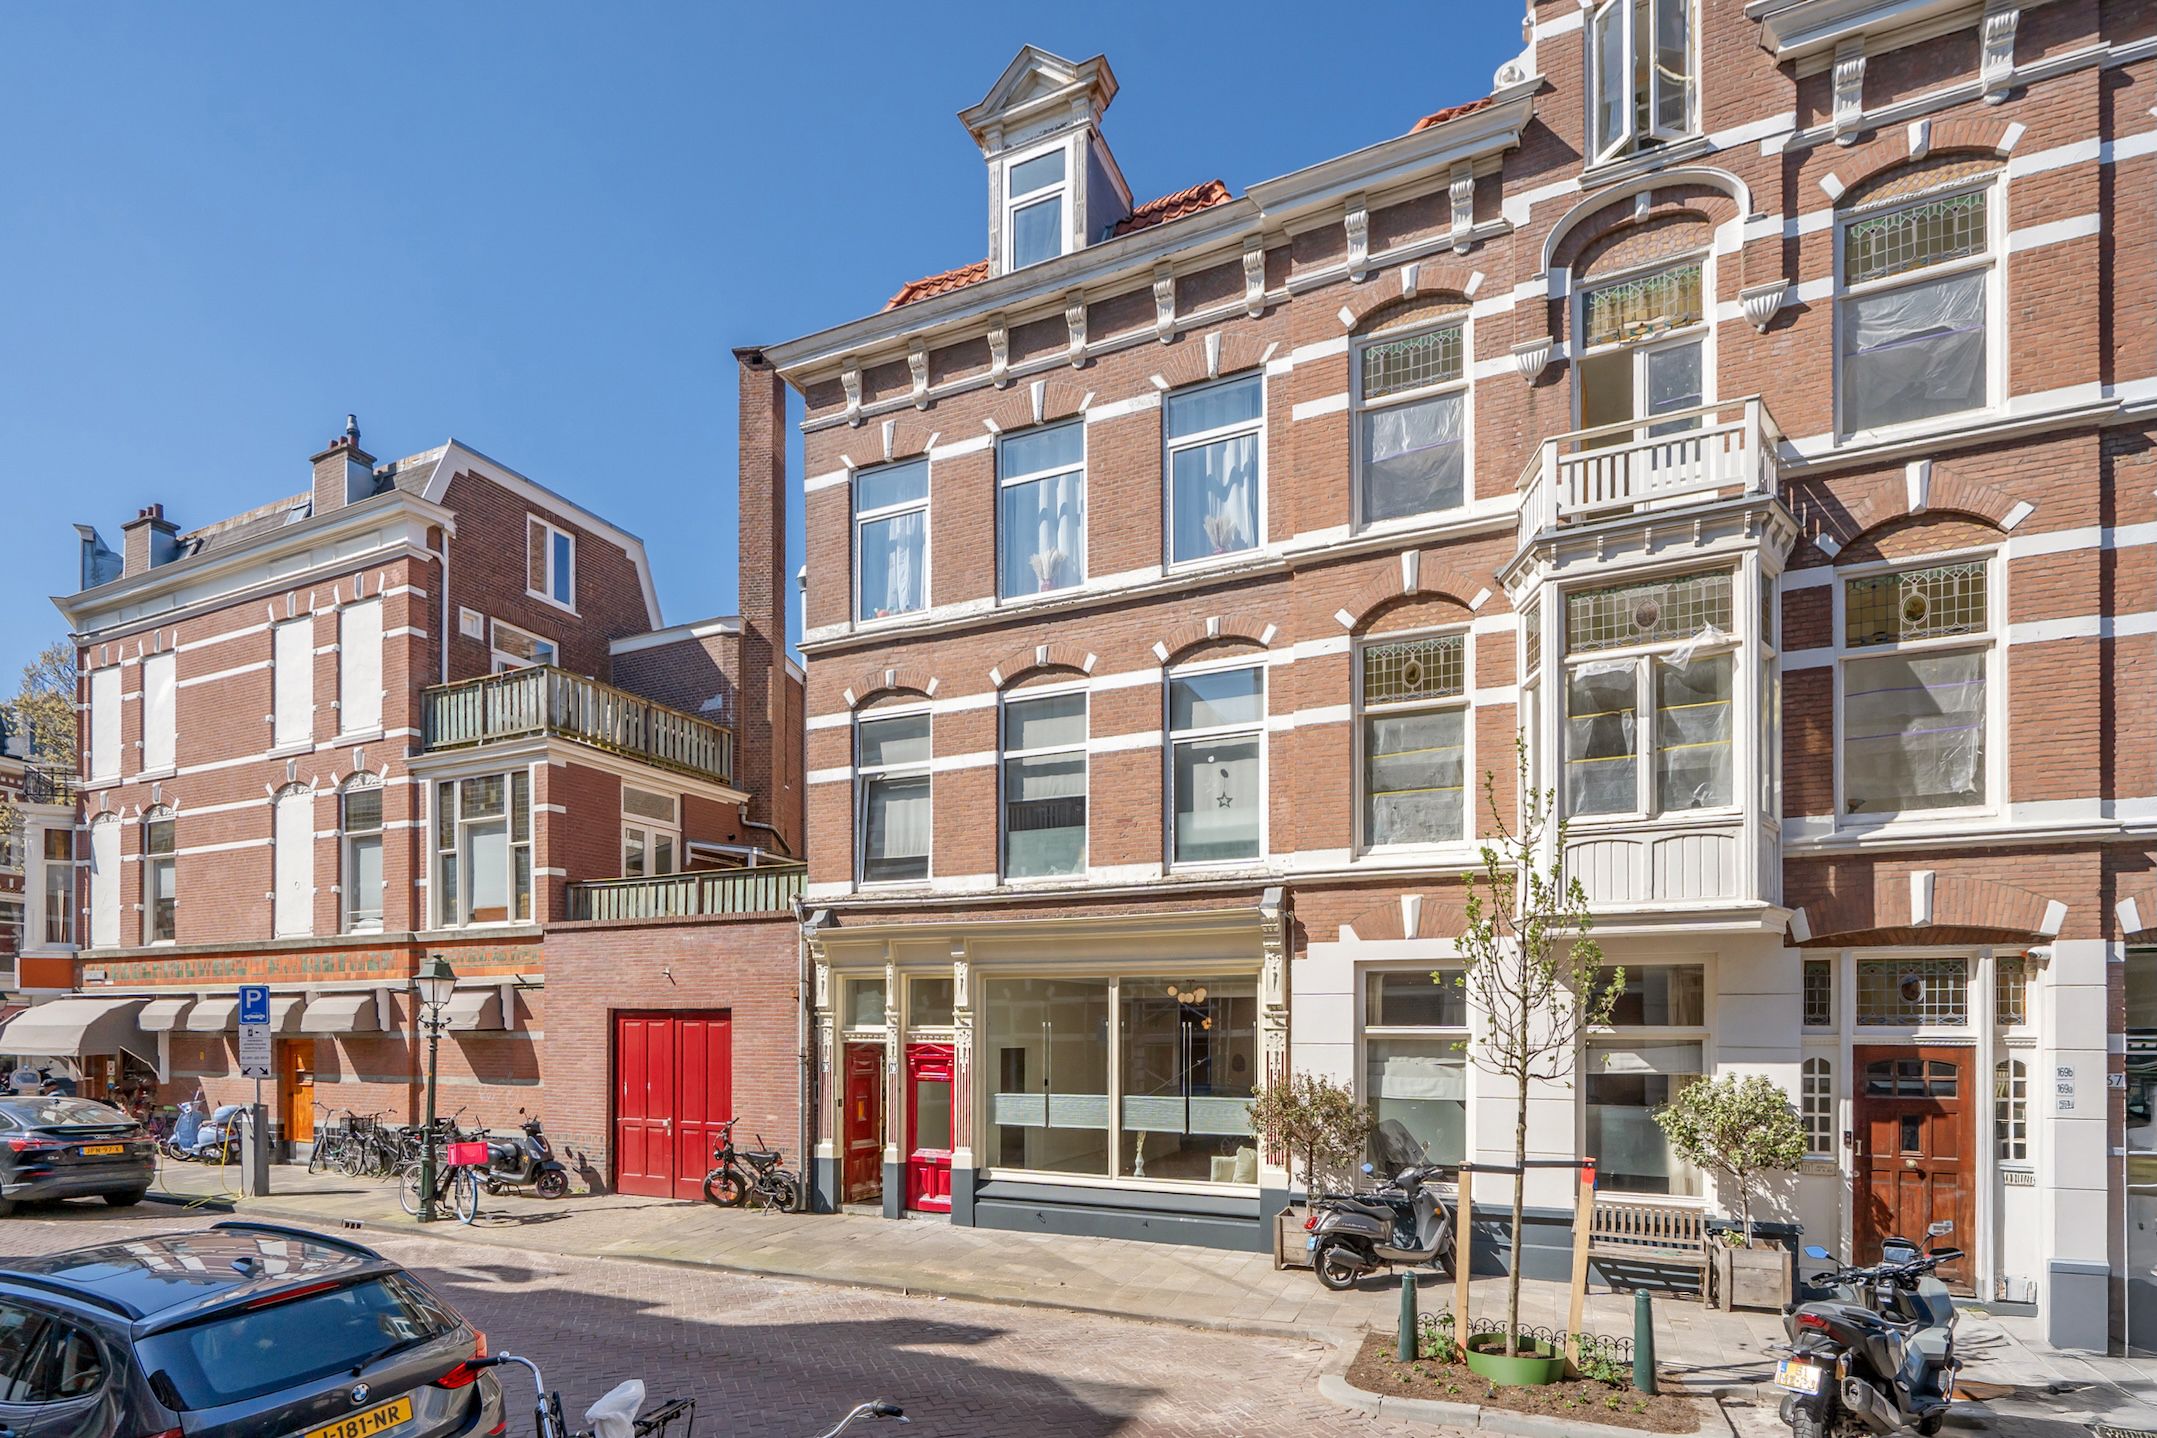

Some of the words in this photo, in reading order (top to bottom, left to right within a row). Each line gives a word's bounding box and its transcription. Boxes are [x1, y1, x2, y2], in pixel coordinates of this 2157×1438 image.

[246, 989, 262, 1009] P
[2056, 1067, 2074, 1078] 169b
[2056, 1083, 2074, 1094] 169a
